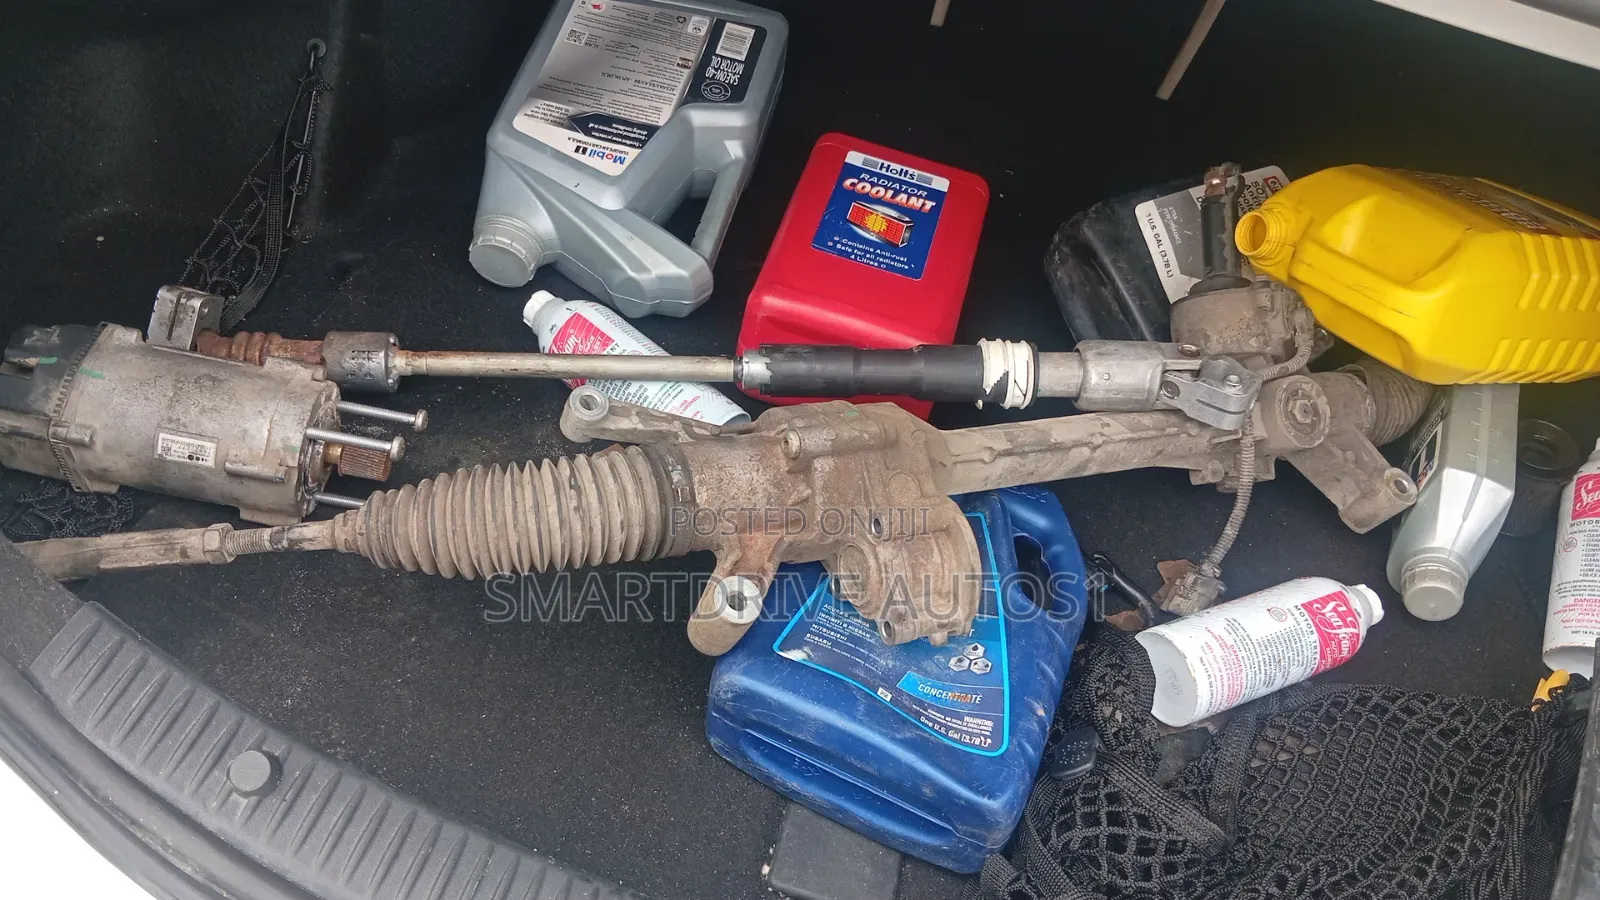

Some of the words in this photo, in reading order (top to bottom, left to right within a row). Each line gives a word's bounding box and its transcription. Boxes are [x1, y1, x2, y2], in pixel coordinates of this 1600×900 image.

[711, 56, 721, 67] OIL
[720, 59, 744, 74] MOTOR
[568, 137, 591, 146] FORMULA
[589, 149, 625, 164] Mobil
[602, 146, 628, 155] EUROPEAN
[879, 162, 917, 181] Holts
[860, 174, 927, 196] RADIATOR
[842, 178, 936, 213] COOLANT
[1169, 207, 1177, 220] XTRA
[1163, 208, 1181, 244] PERFORMANCE
[842, 239, 873, 251] Contains
[875, 249, 907, 262] Anti-rust
[1148, 218, 1156, 232] U.S.
[1154, 233, 1162, 248] GAL
[1159, 250, 1170, 268] (3.78
[1166, 269, 1173, 277] L)
[837, 244, 852, 252] Safe
[876, 257, 908, 269] radiators
[857, 256, 878, 266] Litres
[824, 604, 843, 615] ACURA
[1313, 600, 1346, 627] Sea
[819, 612, 842, 625] INFINITI
[848, 626, 870, 637] NISSAN
[1294, 605, 1313, 635] MOTOR
[806, 633, 831, 645] SUBARU
[812, 624, 847, 640] MITSUBISHI
[1289, 630, 1297, 645] CLEAN
[1294, 628, 1302, 643] CLEAN
[1271, 637, 1279, 652] CLEAN
[1276, 635, 1284, 648] QUIET
[1281, 633, 1289, 655] CONTROL
[1285, 631, 1294, 652] STABILIZE
[919, 684, 981, 703] CONCENTRATE
[964, 716, 993, 727] WARNING:
[920, 716, 932, 727] One
[934, 724, 946, 734] U.S.
[948, 730, 960, 739] Gal
[961, 734, 980, 745] (3.78
